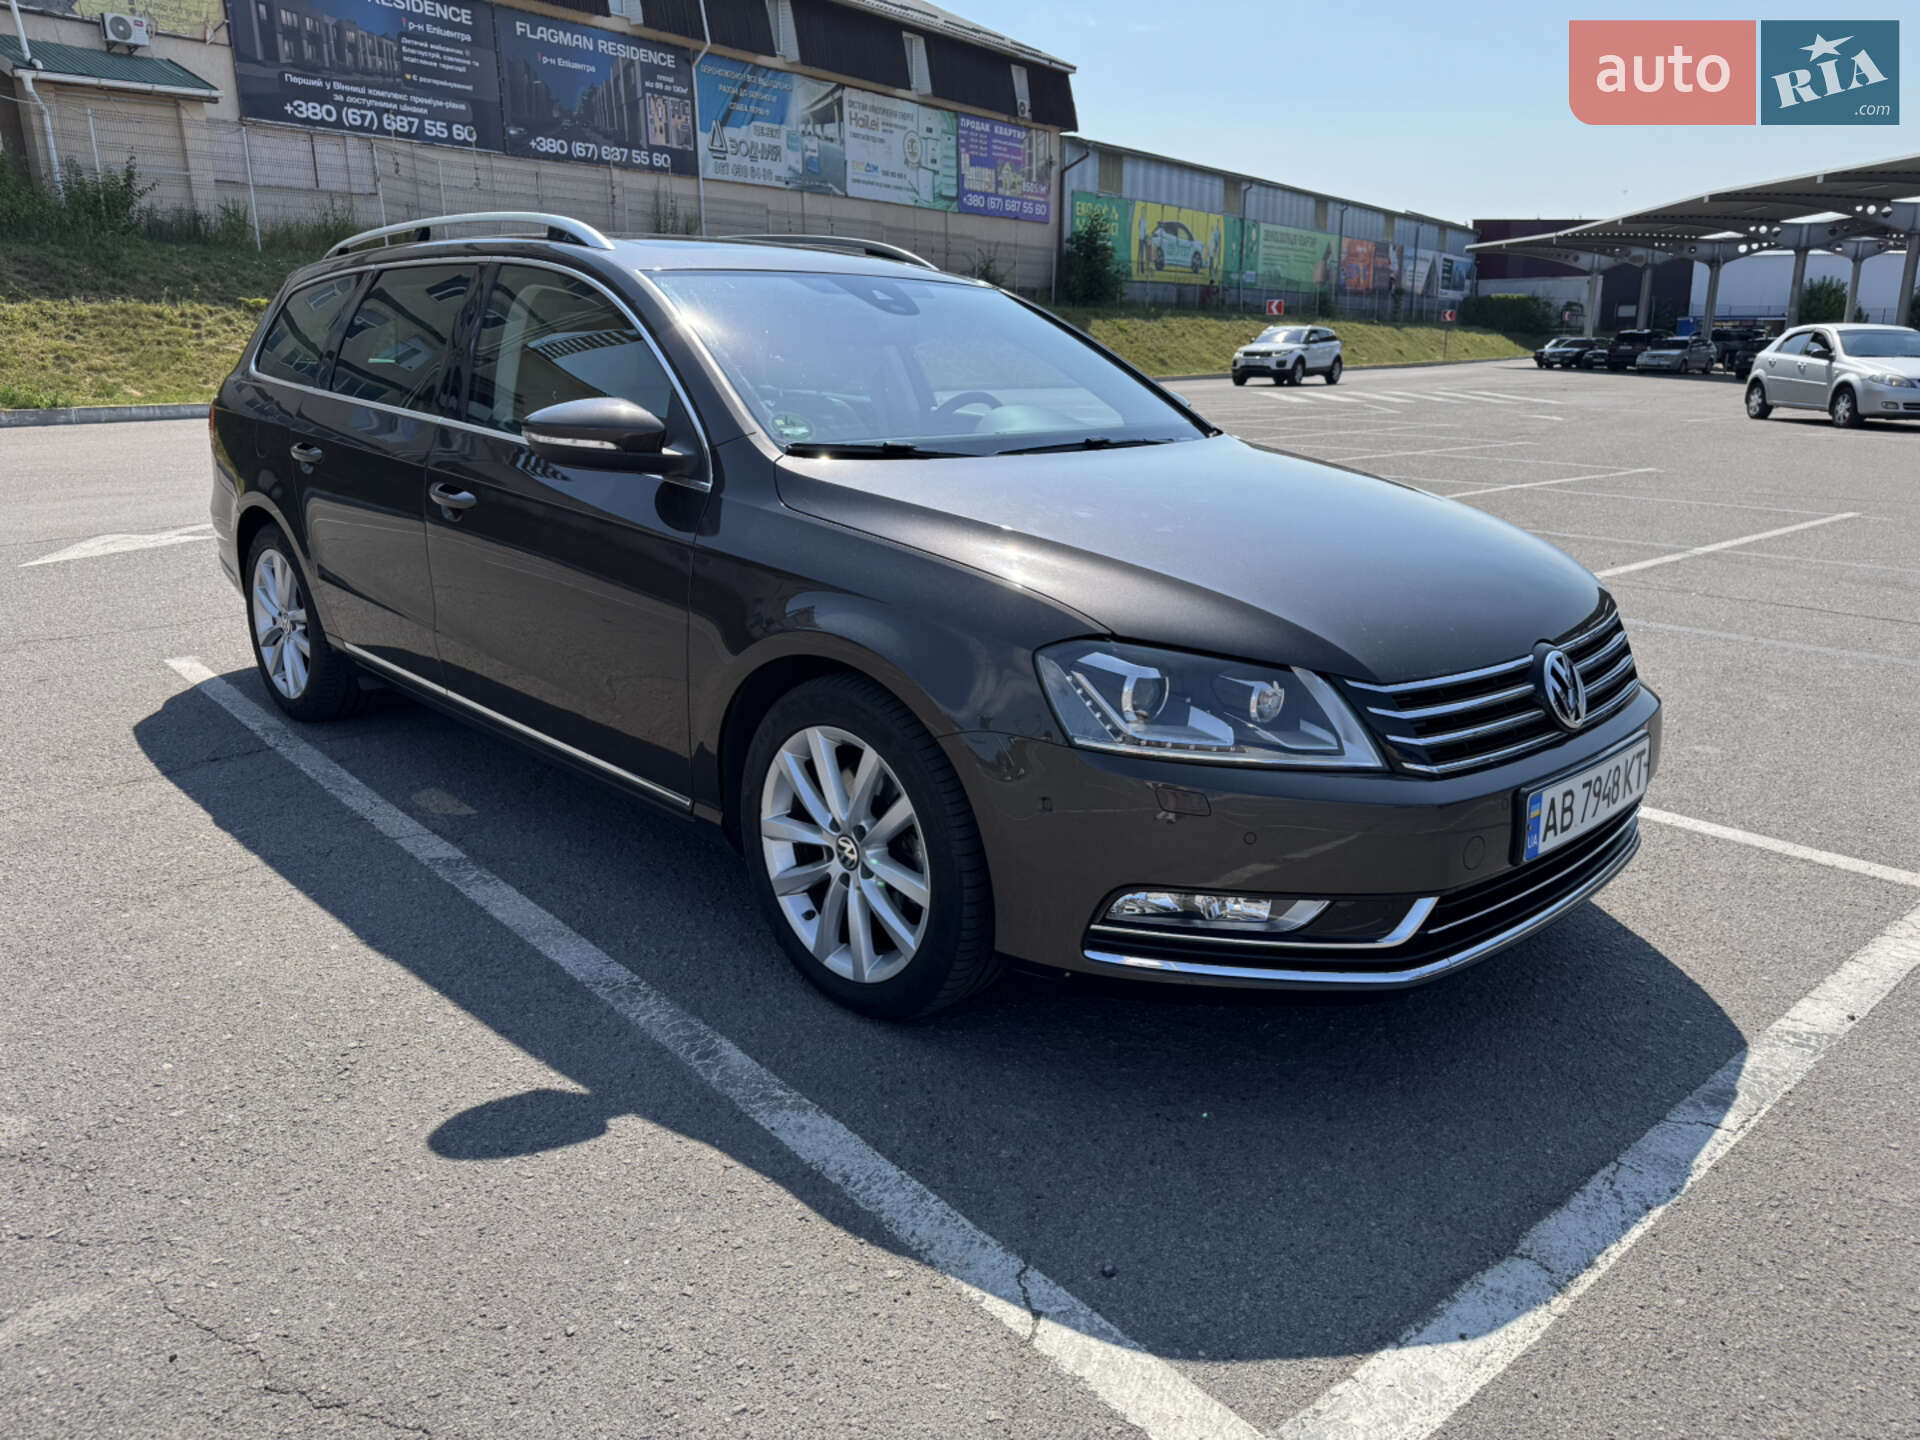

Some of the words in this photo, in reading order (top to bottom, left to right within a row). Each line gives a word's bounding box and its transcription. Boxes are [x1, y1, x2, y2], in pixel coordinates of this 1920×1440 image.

[367, 0, 473, 25] SIDENCE
[515, 21, 593, 51] FLAGMAN
[597, 39, 676, 68] RESIDENCE
[284, 73, 323, 88] Перший
[284, 100, 337, 122] +380
[342, 107, 378, 130] (67)
[382, 112, 419, 134] 687
[424, 119, 448, 138] 55
[452, 123, 477, 142] 60
[529, 136, 568, 155] +380
[571, 140, 598, 160] (67)
[601, 145, 628, 162] 687
[631, 149, 649, 165] 55
[652, 152, 671, 168] 60
[987, 196, 1003, 211] (67)
[1022, 202, 1034, 214] 55
[1035, 204, 1047, 216] 60
[1542, 788, 1575, 843] AB
[1580, 764, 1621, 824] 7948
[1622, 748, 1647, 799] KT
